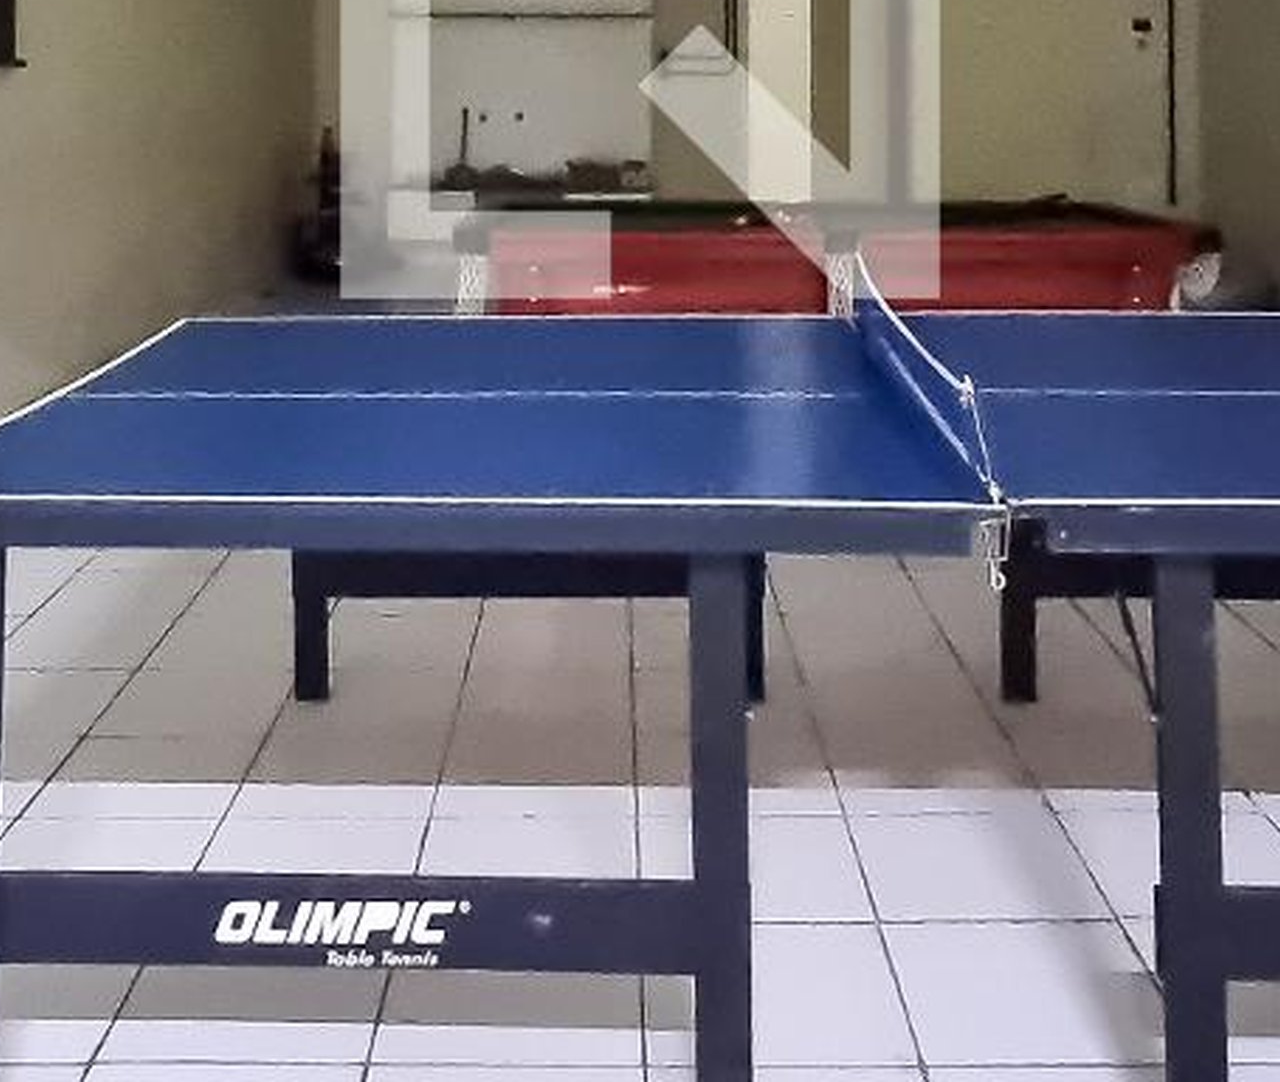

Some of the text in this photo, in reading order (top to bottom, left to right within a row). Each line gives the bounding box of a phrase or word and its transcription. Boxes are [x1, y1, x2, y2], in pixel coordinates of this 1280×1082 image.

[214, 900, 456, 945] OLIMPIC
[326, 950, 439, 967] Table Tennis
